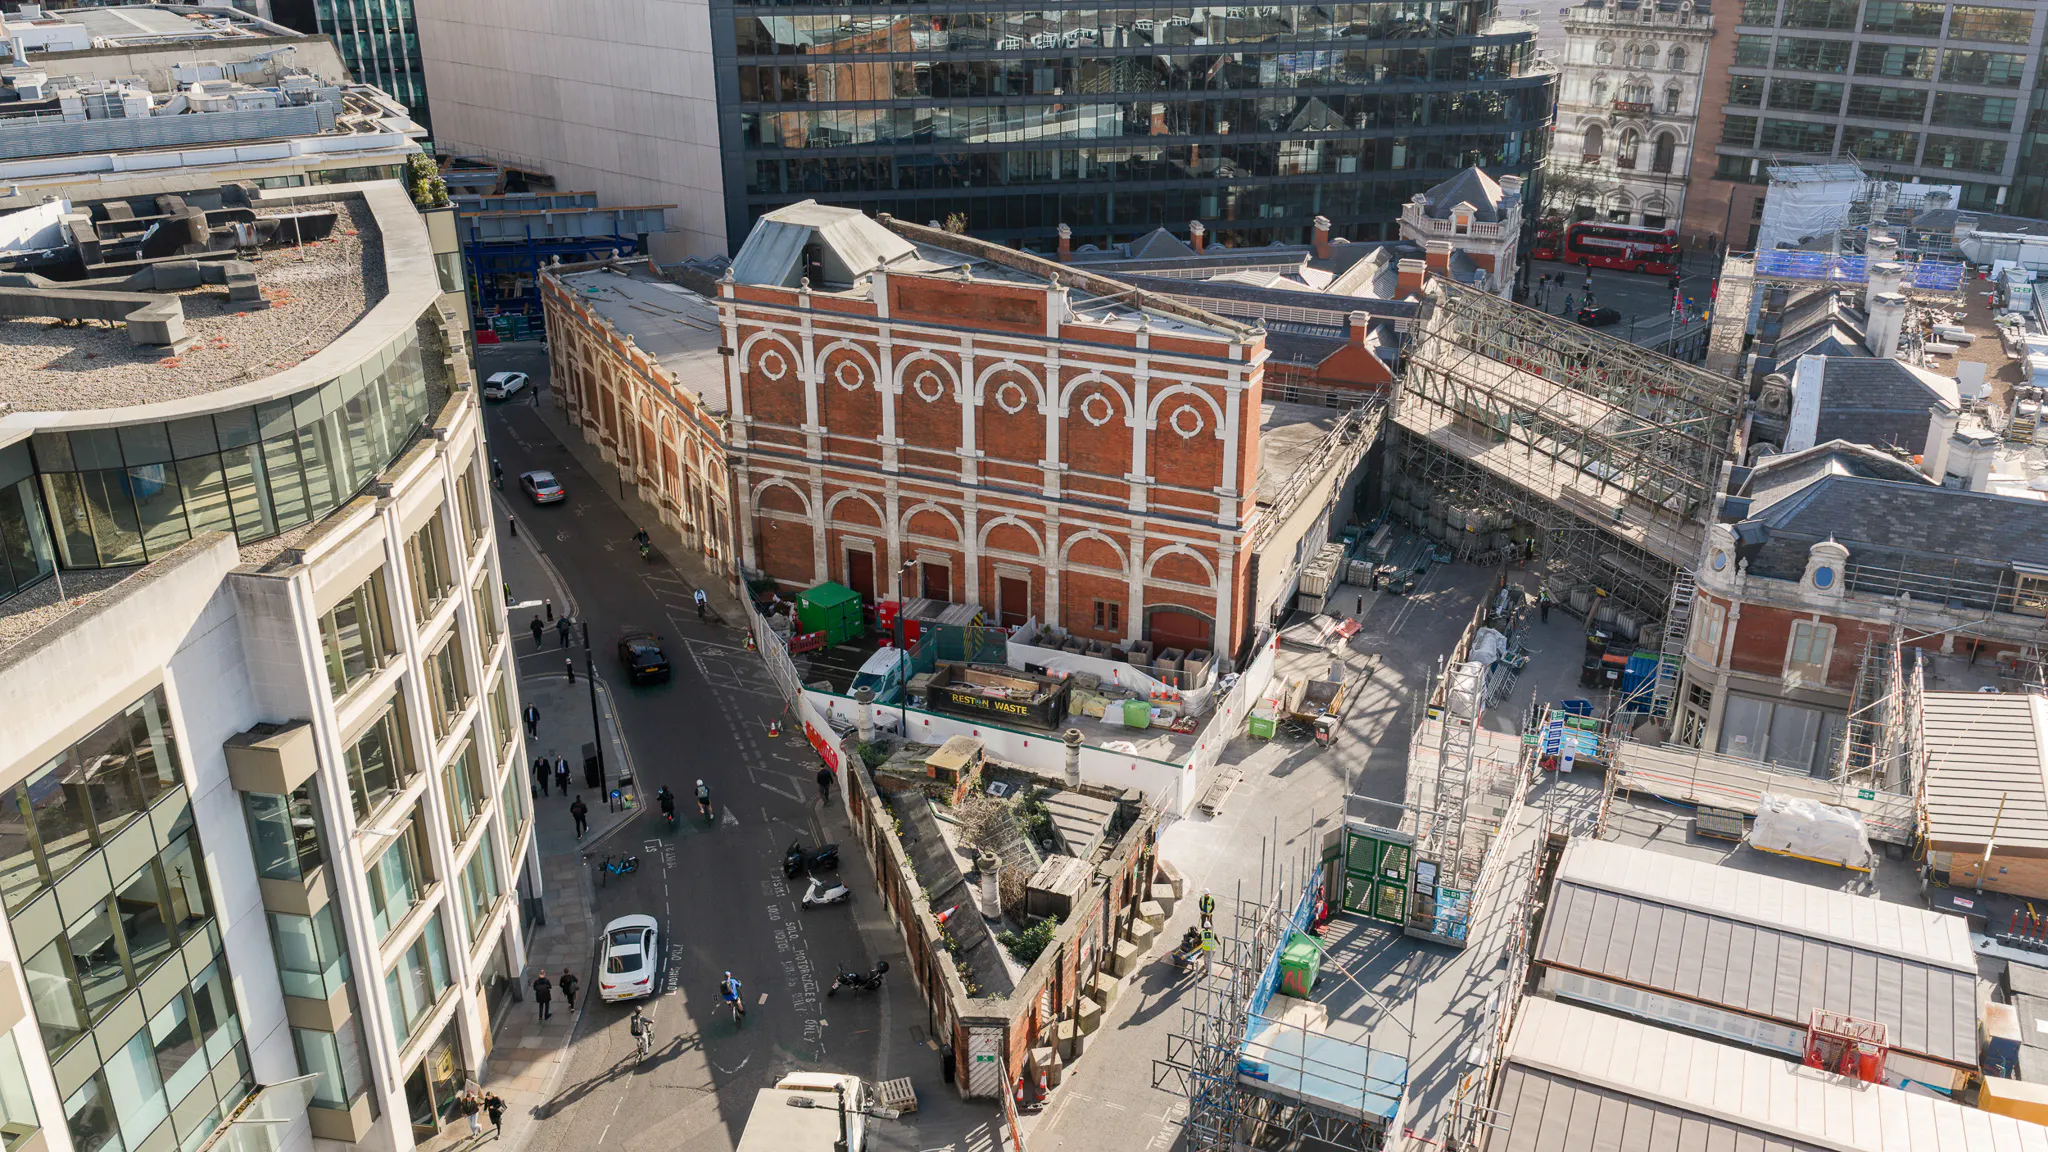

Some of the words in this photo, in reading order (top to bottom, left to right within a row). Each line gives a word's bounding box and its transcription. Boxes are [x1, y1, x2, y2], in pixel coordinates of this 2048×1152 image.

[995, 701, 1028, 715] WASTE
[785, 921, 799, 940] SOLO
[665, 966, 682, 996] LOADING
[794, 950, 816, 1004] MOTORCYCLES
[804, 1019, 818, 1043] ONLY
